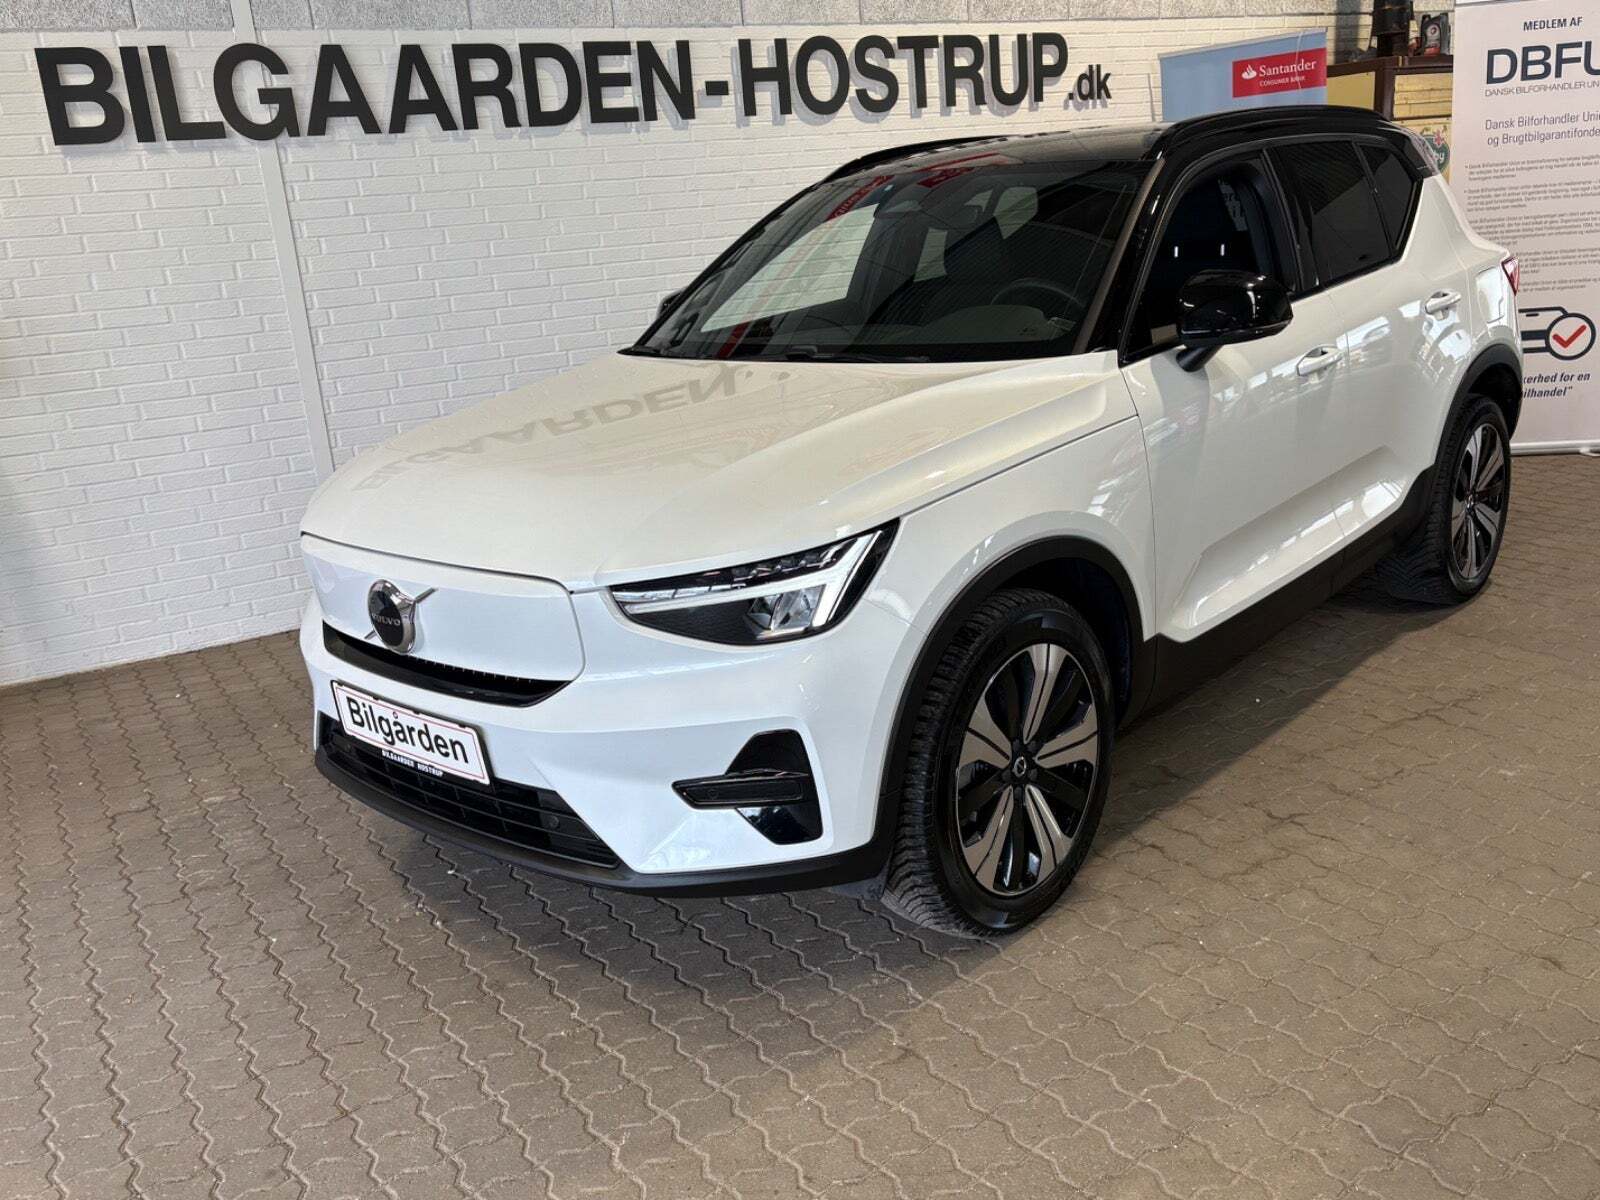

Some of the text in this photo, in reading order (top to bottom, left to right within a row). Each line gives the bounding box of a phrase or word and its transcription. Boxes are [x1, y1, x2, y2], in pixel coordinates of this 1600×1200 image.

[1523, 16, 1583, 31] MEDLEM AF
[1258, 59, 1317, 78] Santander
[1259, 77, 1289, 87] CONSUMER
[1485, 88, 1515, 97] DANSK
[1516, 82, 1586, 95] BILFORHANDLER
[1485, 118, 1515, 131] Dansk
[1518, 113, 1579, 128] Bilforhandler
[1487, 136, 1499, 148] og
[1559, 372, 1574, 383] for
[1577, 373, 1591, 382] en
[346, 697, 469, 764] Bilgården
